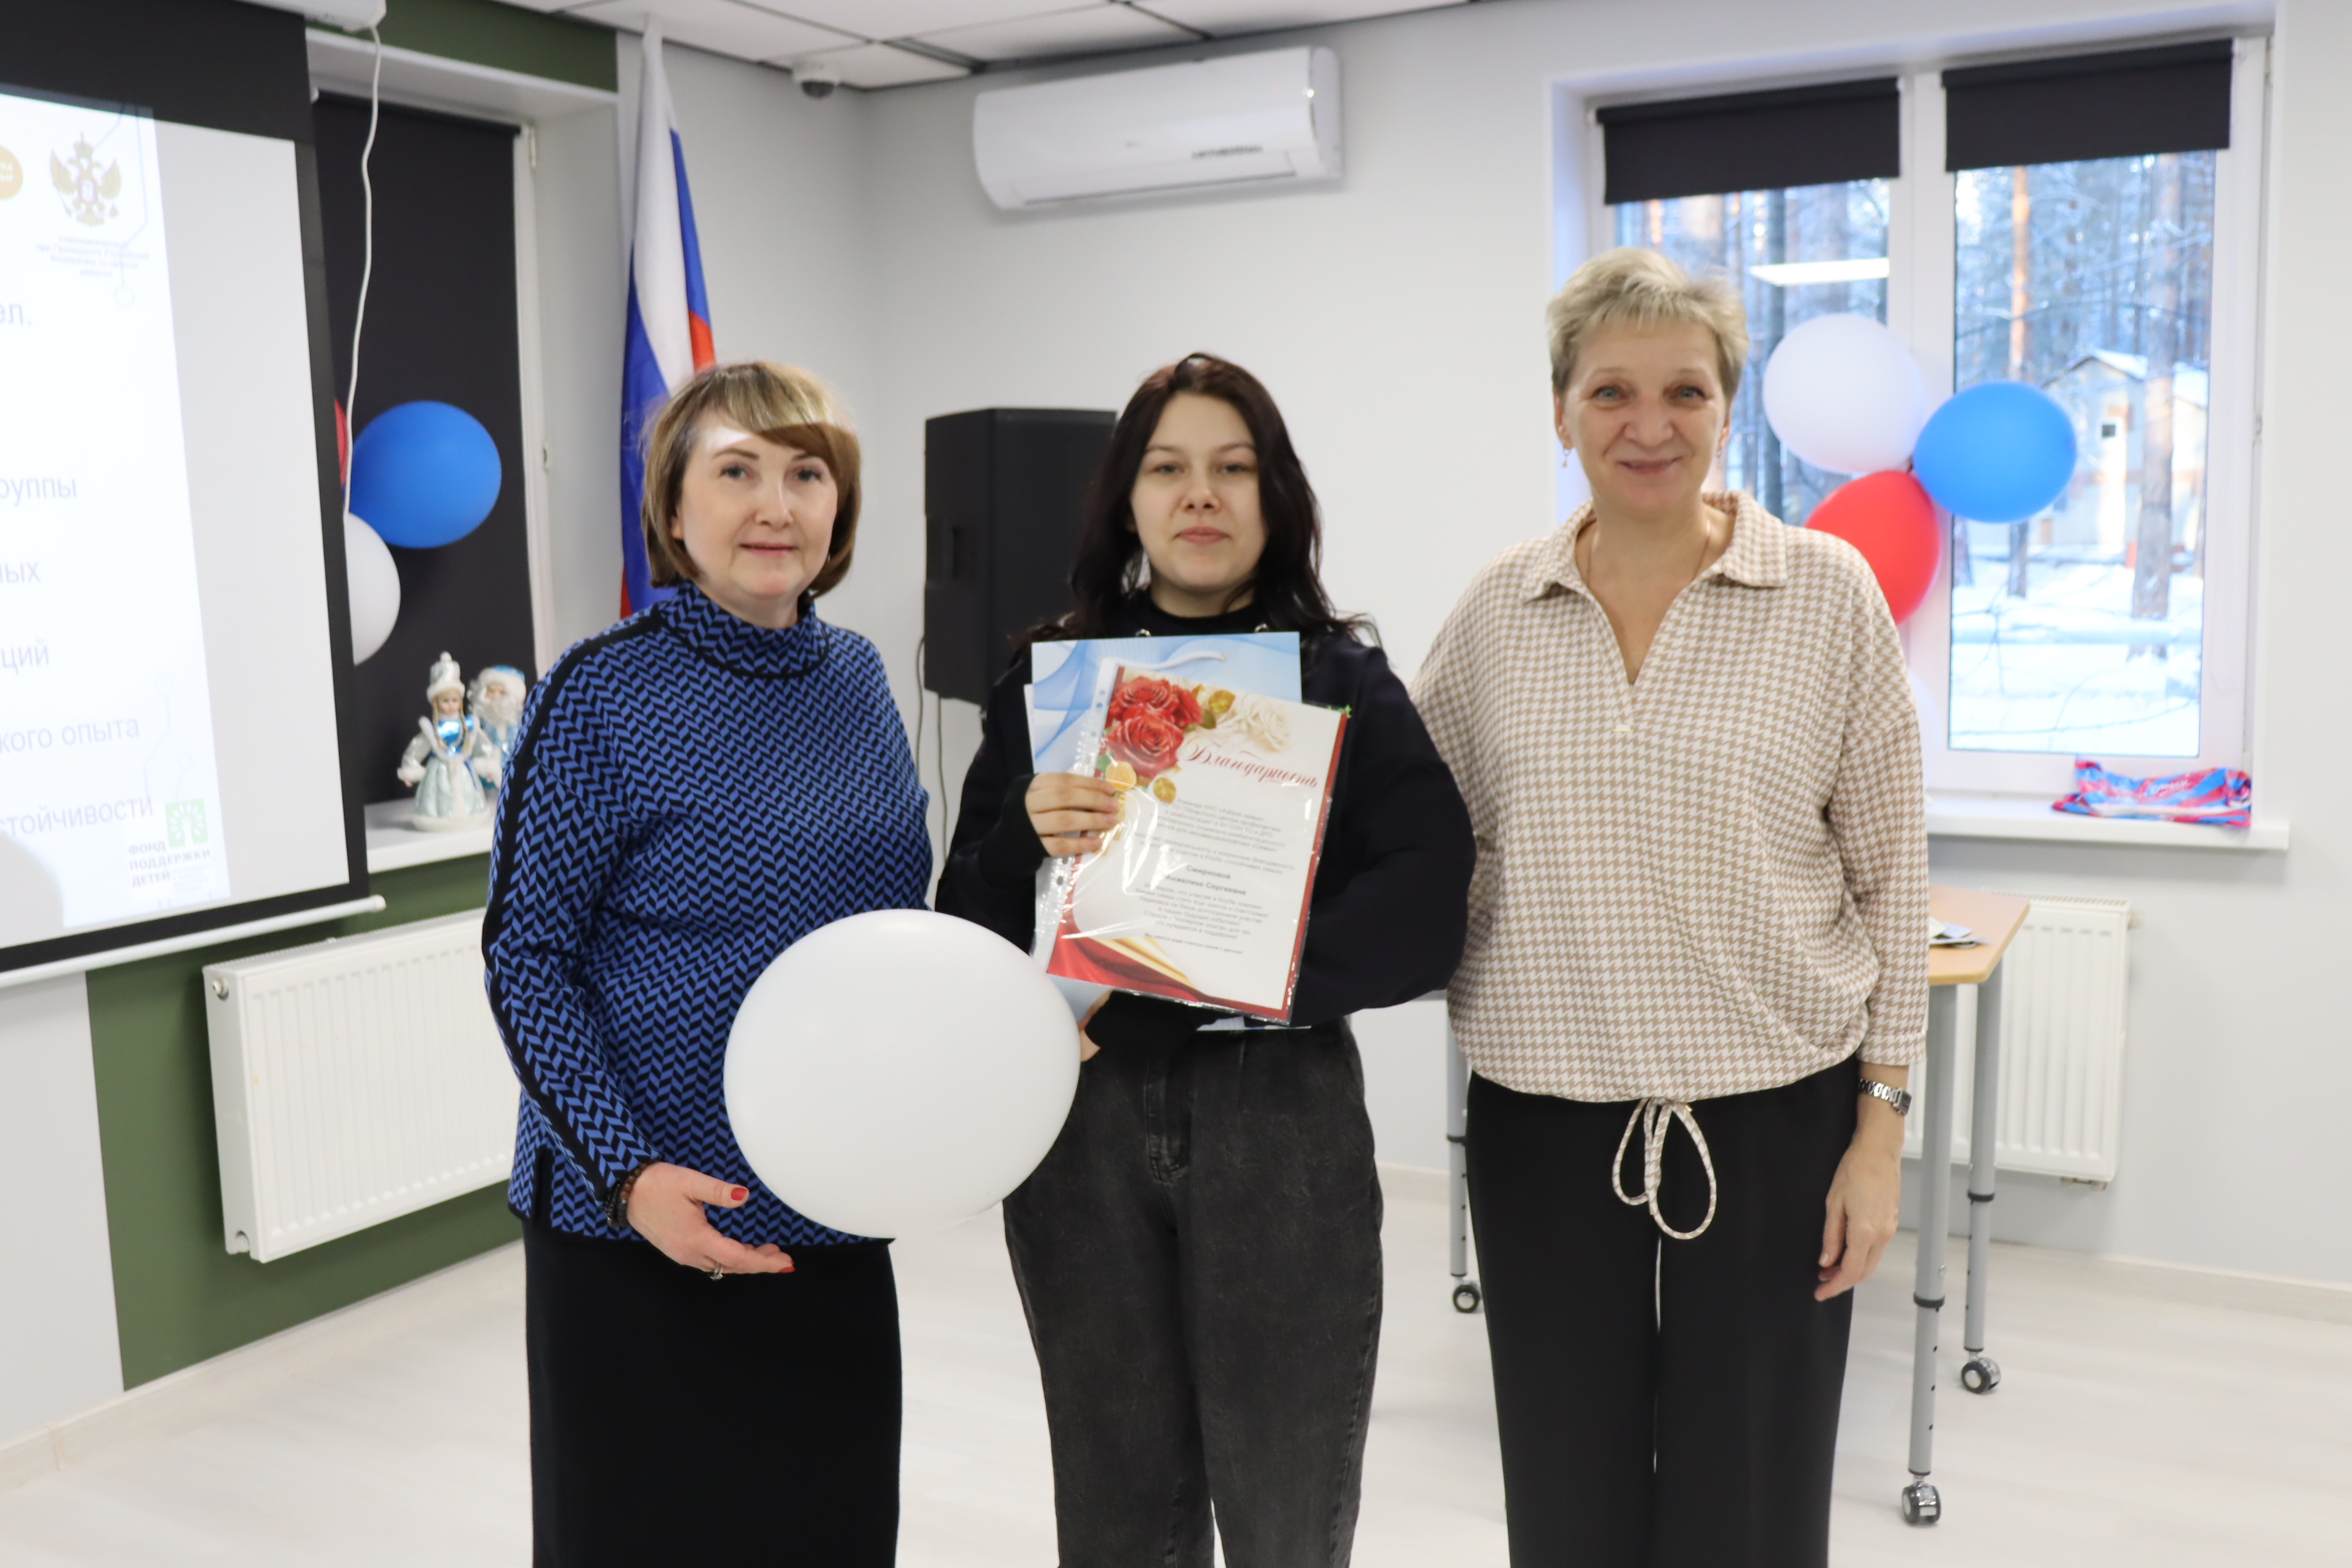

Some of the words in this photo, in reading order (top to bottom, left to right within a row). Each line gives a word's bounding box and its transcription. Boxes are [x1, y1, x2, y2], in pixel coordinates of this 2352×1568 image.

[1, 637, 51, 676] ций
[62, 717, 140, 746] опыта
[1184, 741, 1318, 789] Благодарность
[0, 796, 153, 837] тойчивости
[128, 840, 167, 855] ФОНД
[130, 849, 211, 871] ПОДДЕРЖКИ
[131, 869, 171, 888] ДЕТЕЙ
[1185, 865, 1231, 880] Смирновой
[1165, 873, 1204, 888] Анжелике
[1205, 881, 1247, 895] Сергеевне
